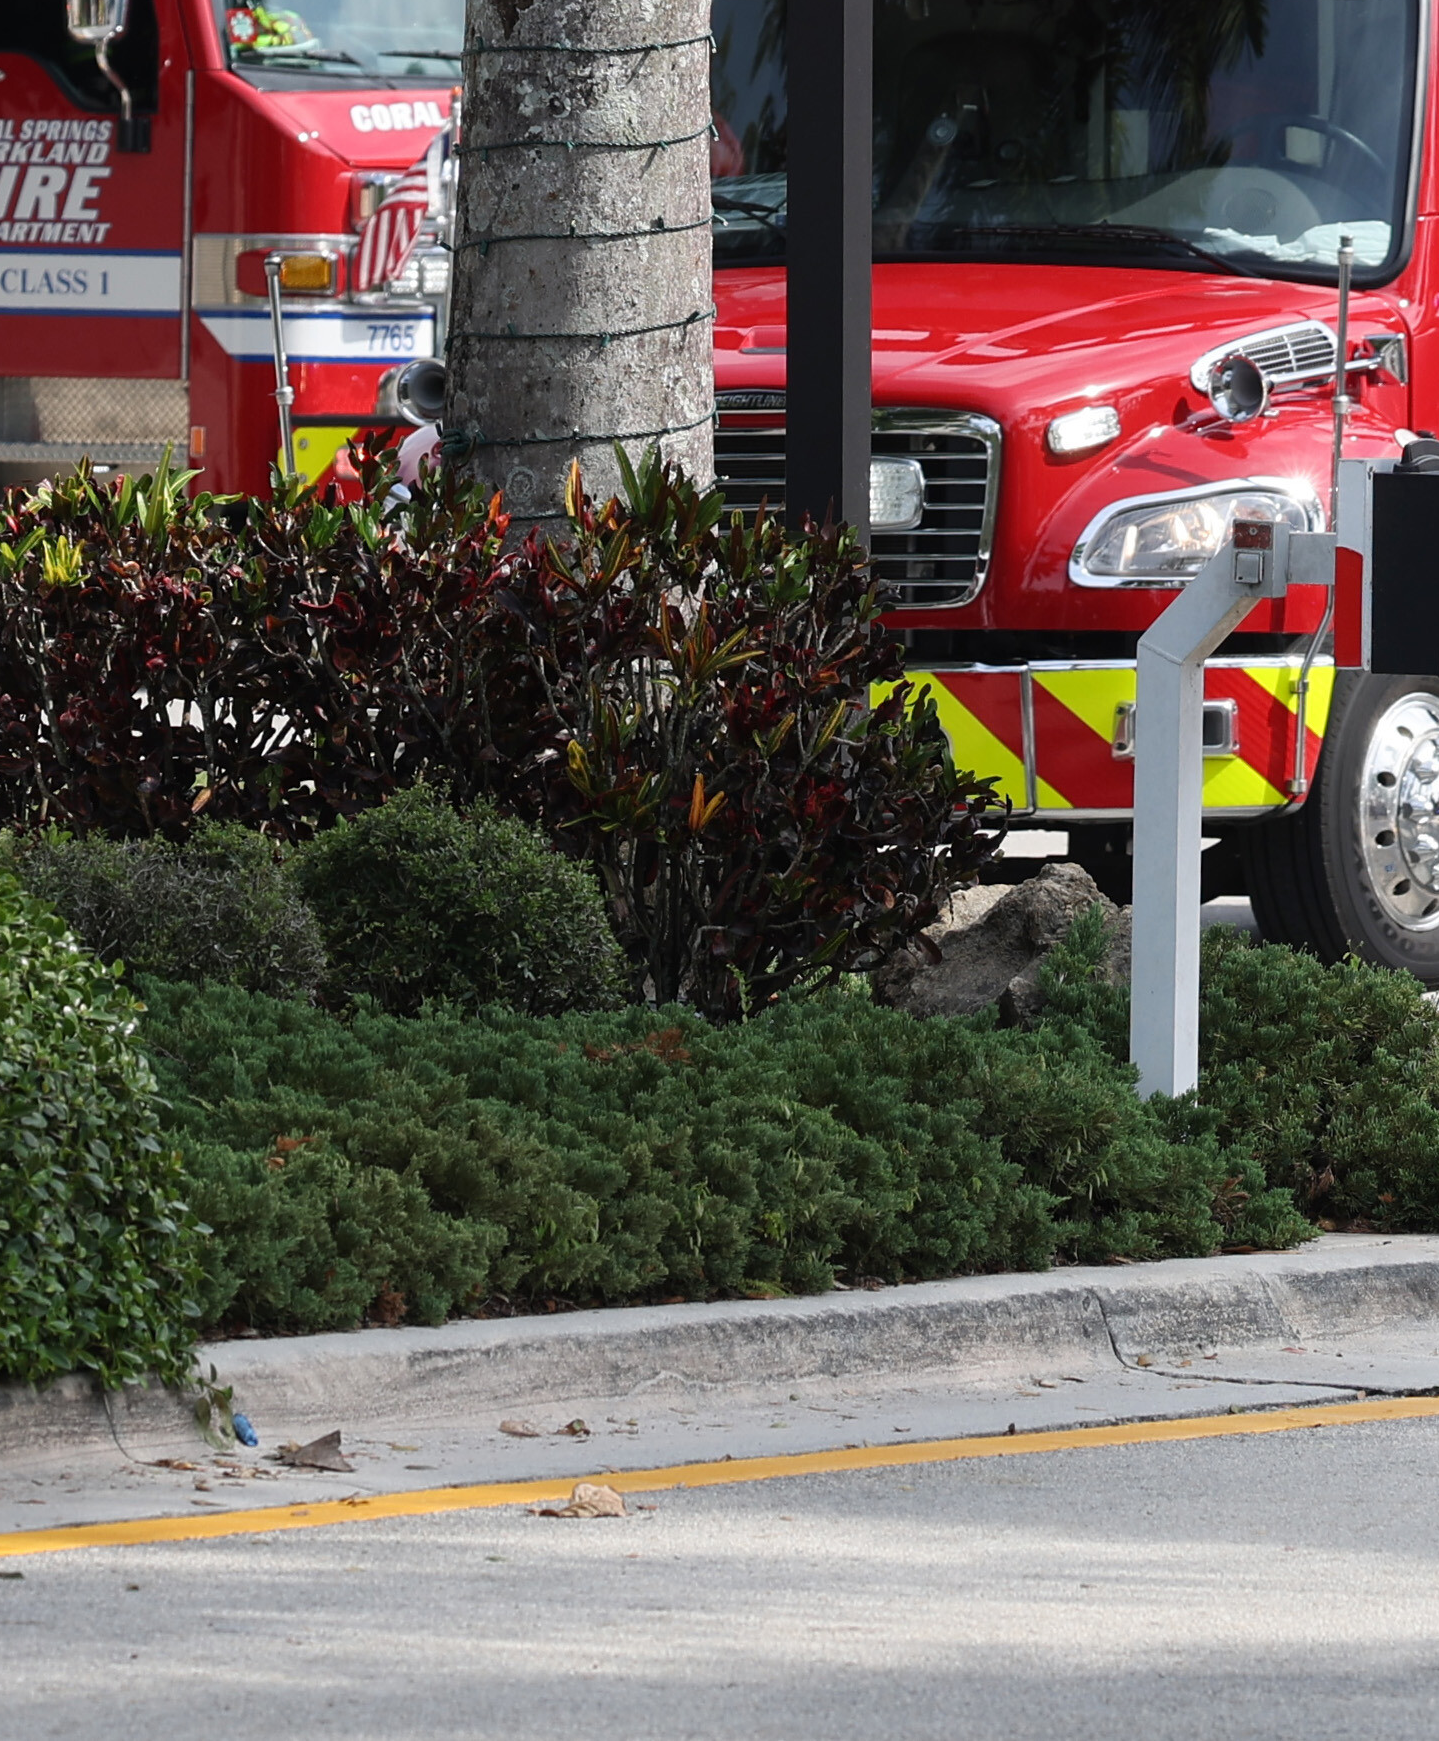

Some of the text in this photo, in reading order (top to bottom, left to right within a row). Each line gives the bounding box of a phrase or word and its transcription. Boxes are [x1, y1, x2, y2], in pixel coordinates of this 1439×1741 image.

[19, 119, 113, 142] SPRINGS
[350, 100, 446, 134] CORAL
[0, 268, 89, 295] CLASS
[99, 270, 109, 296] 1
[367, 323, 415, 352] 7765
